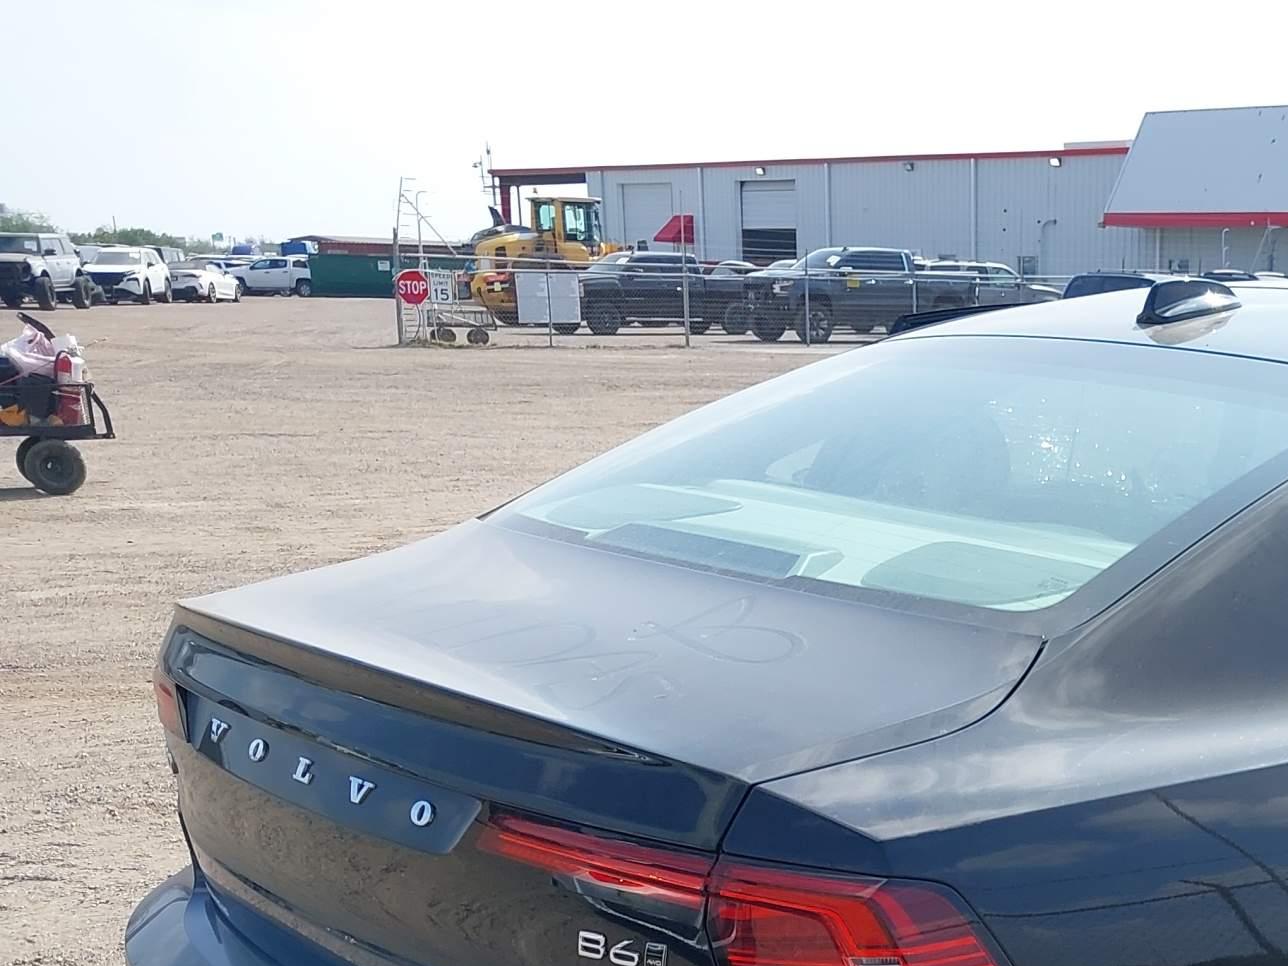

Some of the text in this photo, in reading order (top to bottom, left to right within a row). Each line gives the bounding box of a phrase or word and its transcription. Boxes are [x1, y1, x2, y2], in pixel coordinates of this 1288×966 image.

[431, 272, 451, 280] SPEED
[398, 280, 427, 295] STOP
[433, 287, 450, 302] 15
[210, 718, 438, 827] VOLVO
